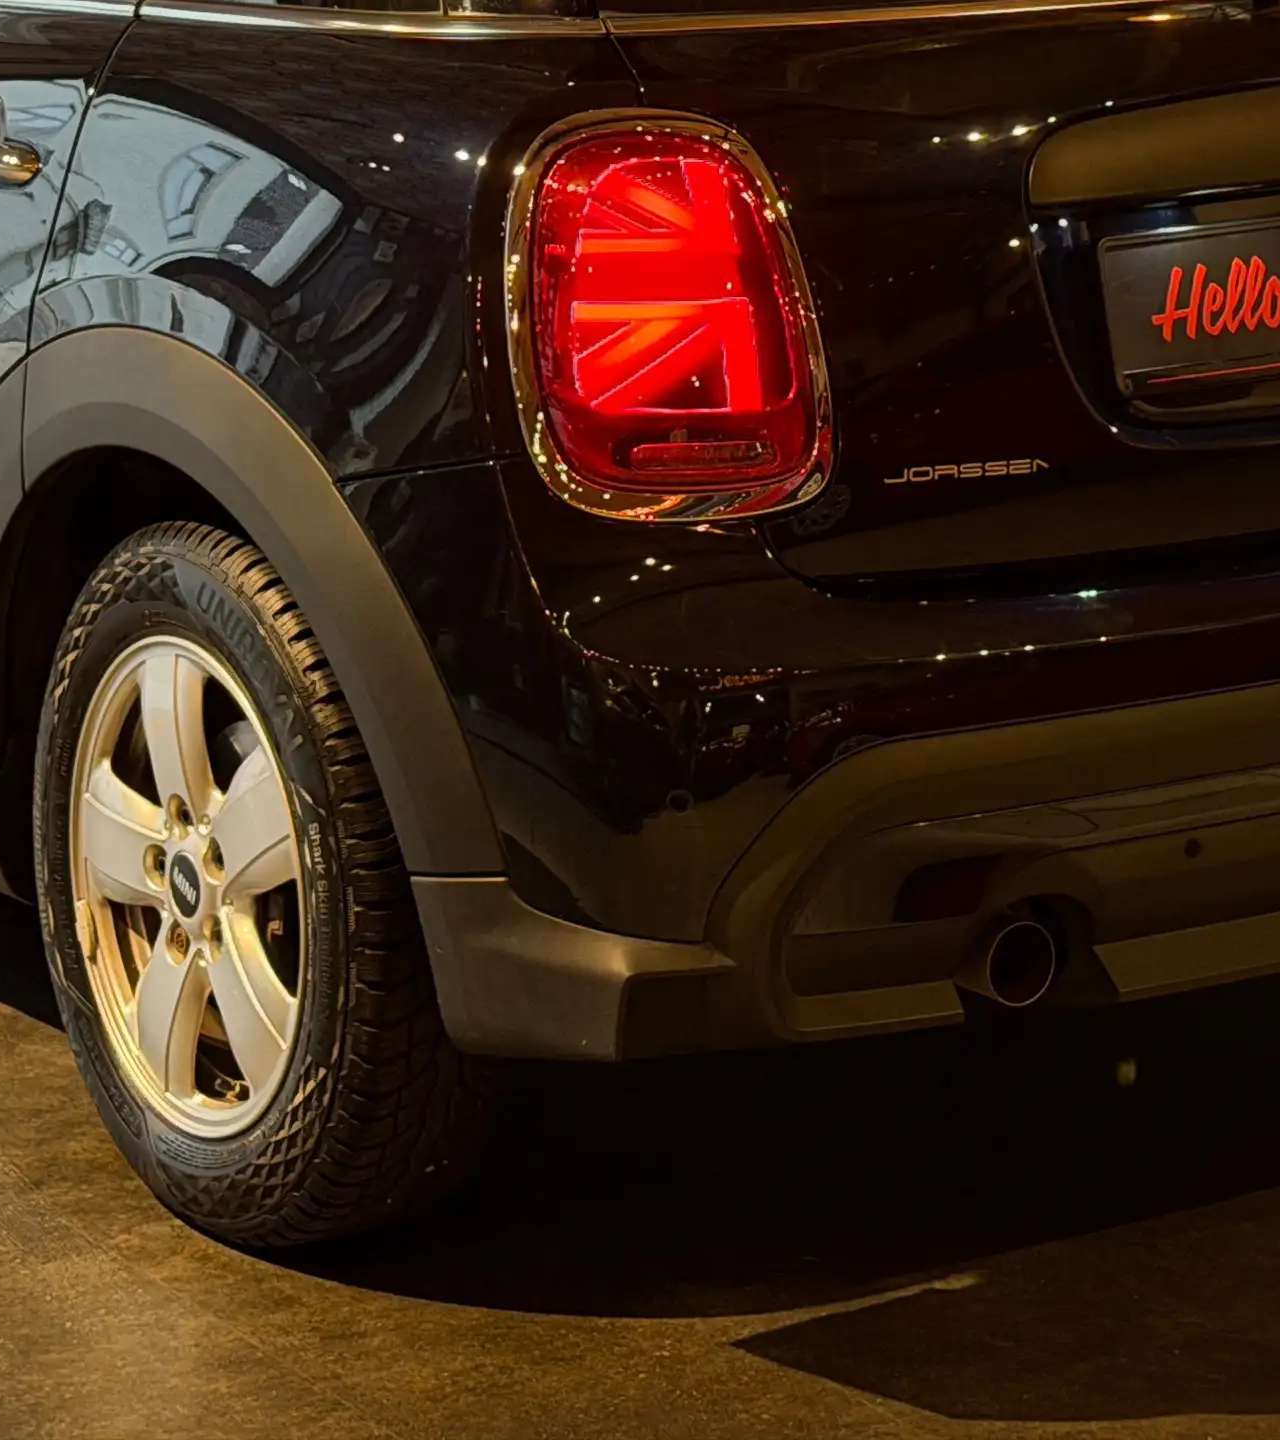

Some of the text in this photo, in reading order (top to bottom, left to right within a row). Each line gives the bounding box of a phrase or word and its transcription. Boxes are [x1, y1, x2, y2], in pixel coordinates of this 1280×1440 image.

[197, 581, 305, 755] UNIROYAL
[308, 821, 328, 875] Shark
[172, 865, 198, 906] MINI
